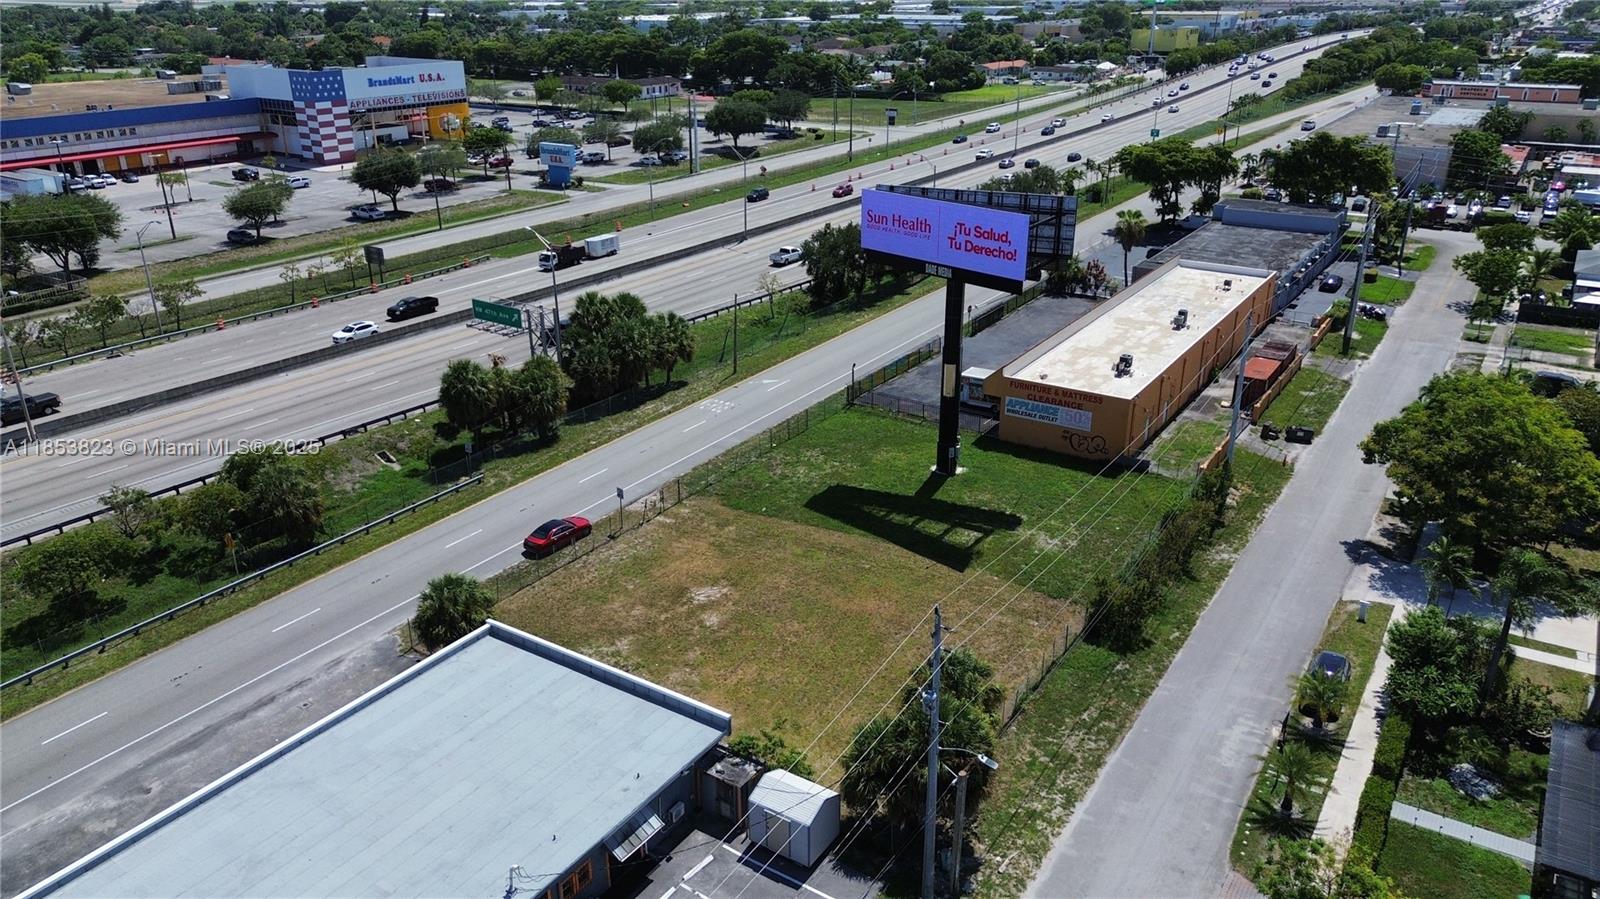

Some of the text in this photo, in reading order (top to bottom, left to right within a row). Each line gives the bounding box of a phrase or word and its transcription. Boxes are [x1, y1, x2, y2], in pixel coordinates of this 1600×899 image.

[419, 72, 445, 83] U.S.A.
[350, 89, 465, 109] APPLIANCES TELEVISIONS
[867, 209, 932, 233] Sun Health
[974, 225, 1011, 247] Salud,
[947, 236, 1017, 261] Tu Derecho!
[1009, 381, 1052, 395] FURNITURE
[1062, 390, 1104, 405] MATTRESS
[1027, 393, 1084, 410] CLEARANCE
[1006, 398, 1060, 416] APPLIANCE
[1006, 408, 1037, 419] WHOLESALE
[1038, 414, 1058, 423] OUTLET
